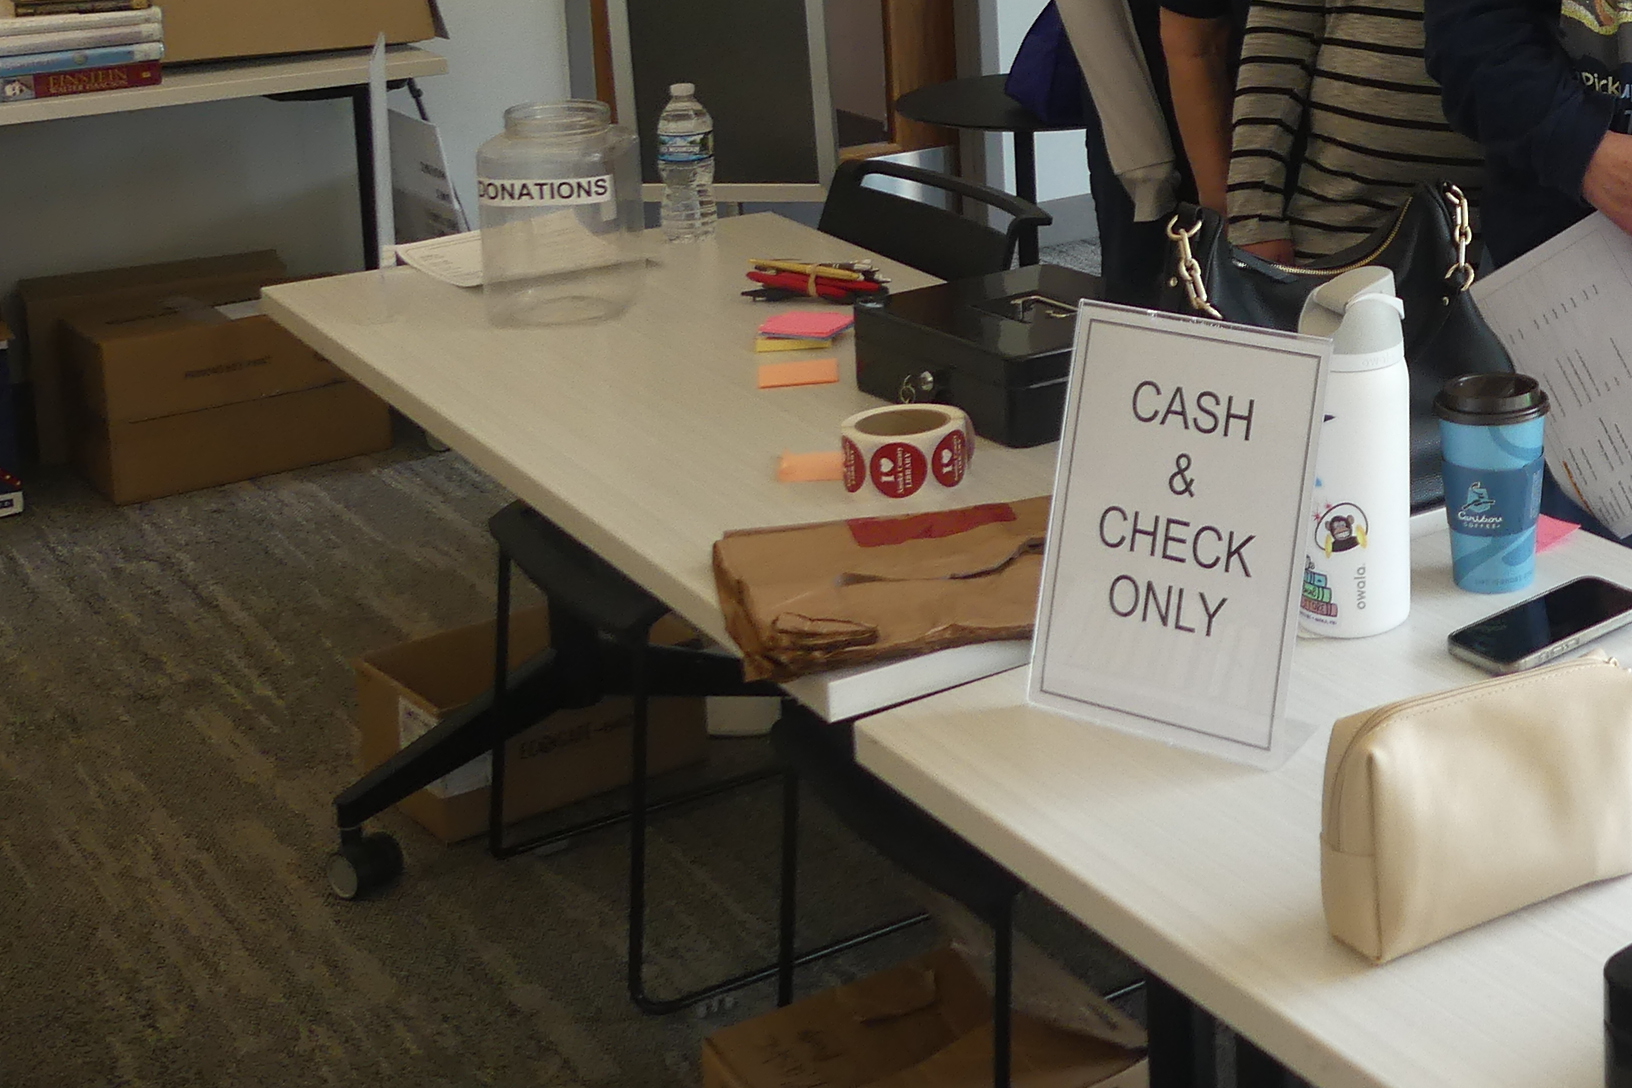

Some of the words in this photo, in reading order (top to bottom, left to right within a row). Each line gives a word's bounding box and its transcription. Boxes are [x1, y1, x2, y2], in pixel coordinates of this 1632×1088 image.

[49, 67, 127, 88] EINSTEIN
[478, 177, 608, 201] DONATIONS
[1132, 380, 1255, 441] CASH
[904, 451, 913, 488] LIBRARY
[1168, 453, 1195, 498] &
[1458, 512, 1502, 523] Caribou
[1463, 521, 1497, 529] COFFEE
[1099, 506, 1256, 578] CHECK
[1108, 574, 1228, 637] ONLY
[1353, 565, 1367, 610] owala
